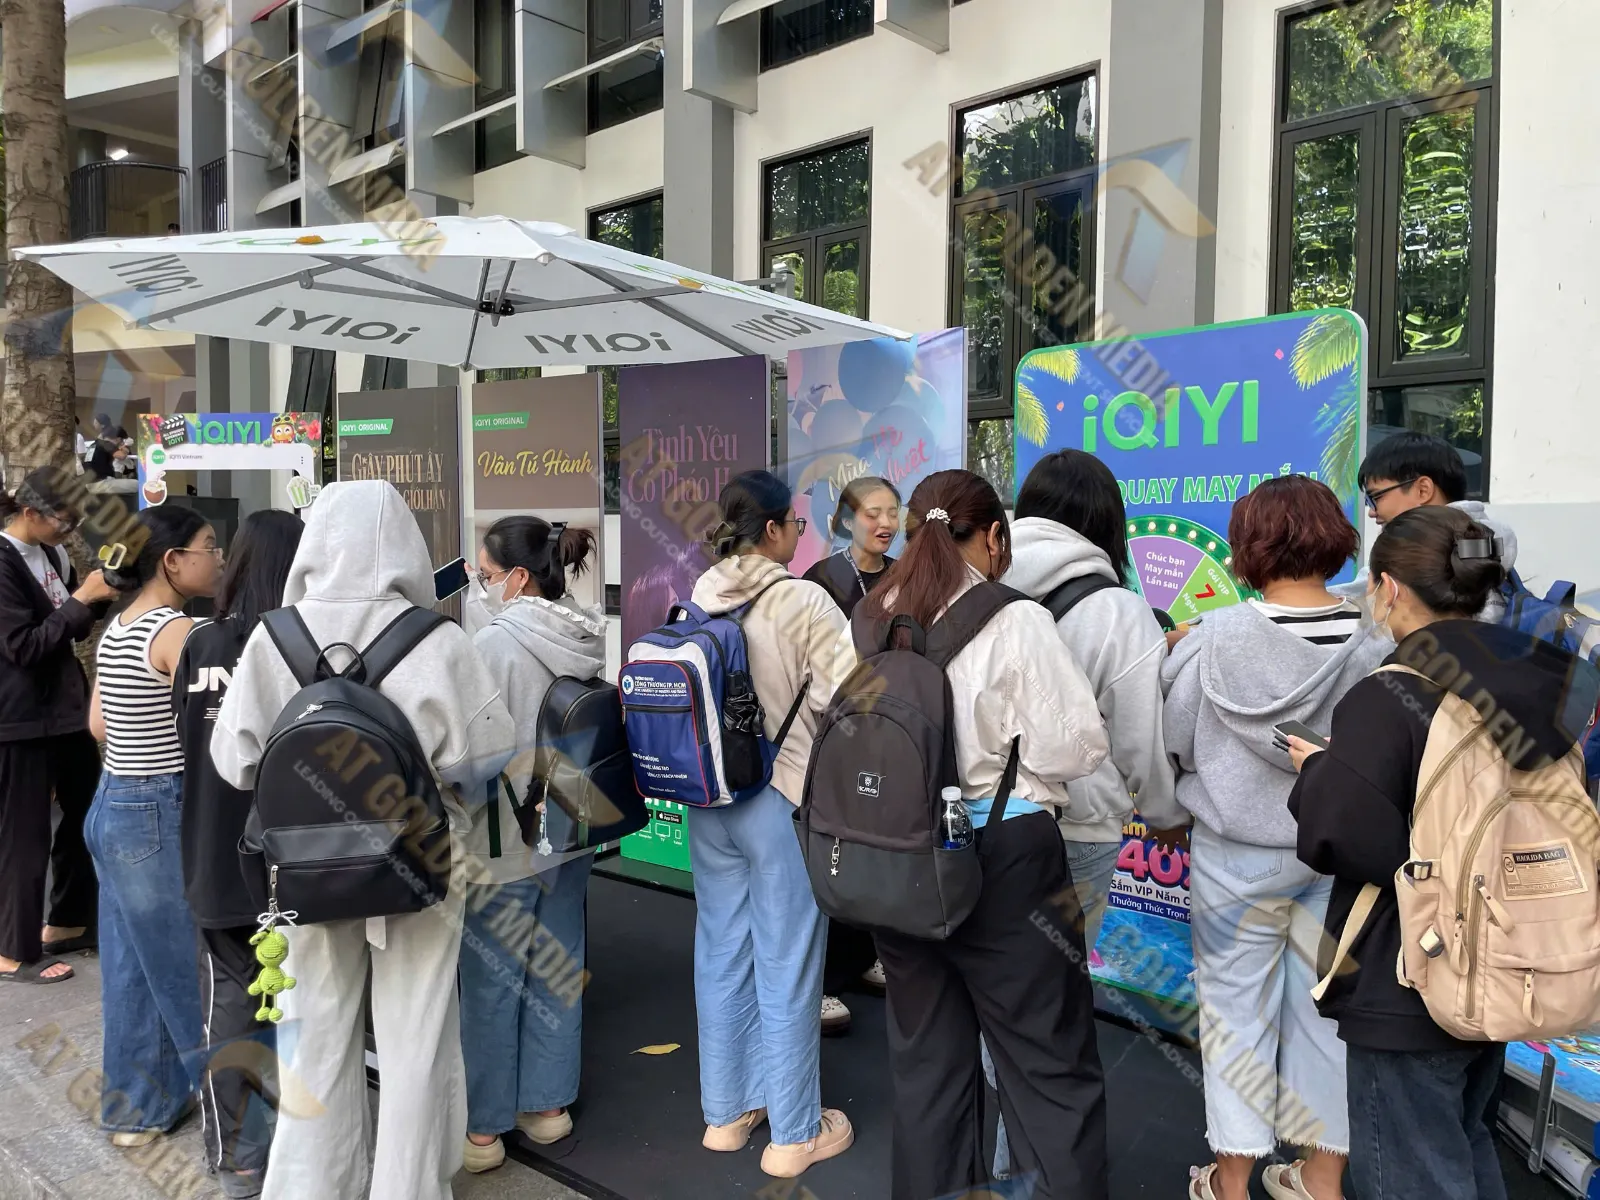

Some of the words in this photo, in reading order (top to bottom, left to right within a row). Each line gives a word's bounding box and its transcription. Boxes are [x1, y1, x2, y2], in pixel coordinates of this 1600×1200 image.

[358, 423, 388, 432] ORIGINAL
[493, 416, 525, 426] ORIGINAL
[1083, 380, 1259, 453] iQIYI
[194, 420, 262, 445] iQIYI
[642, 425, 694, 465] Tình
[696, 424, 739, 462] Yêu
[386, 450, 423, 483] PHÚT
[477, 450, 516, 478] Vân
[518, 450, 539, 476] Tú
[542, 448, 593, 478] Hành
[1116, 477, 1178, 507] QUAY
[1183, 474, 1243, 503] MAY
[1144, 563, 1163, 576] May
[1146, 551, 1169, 564] Chúc
[1169, 554, 1186, 567] bạn
[1163, 578, 1179, 590] sau
[1195, 583, 1216, 600] 7
[1207, 568, 1223, 585] Gói
[1218, 581, 1231, 597] VIP
[1543, 850, 1561, 860] BAG
[1110, 879, 1132, 893] Sắm
[1135, 884, 1153, 896] VIP
[1155, 890, 1180, 904] Năm
[1111, 895, 1142, 911] Thưởng
[1144, 901, 1164, 915] Thức
[1166, 907, 1185, 920] Trọn
